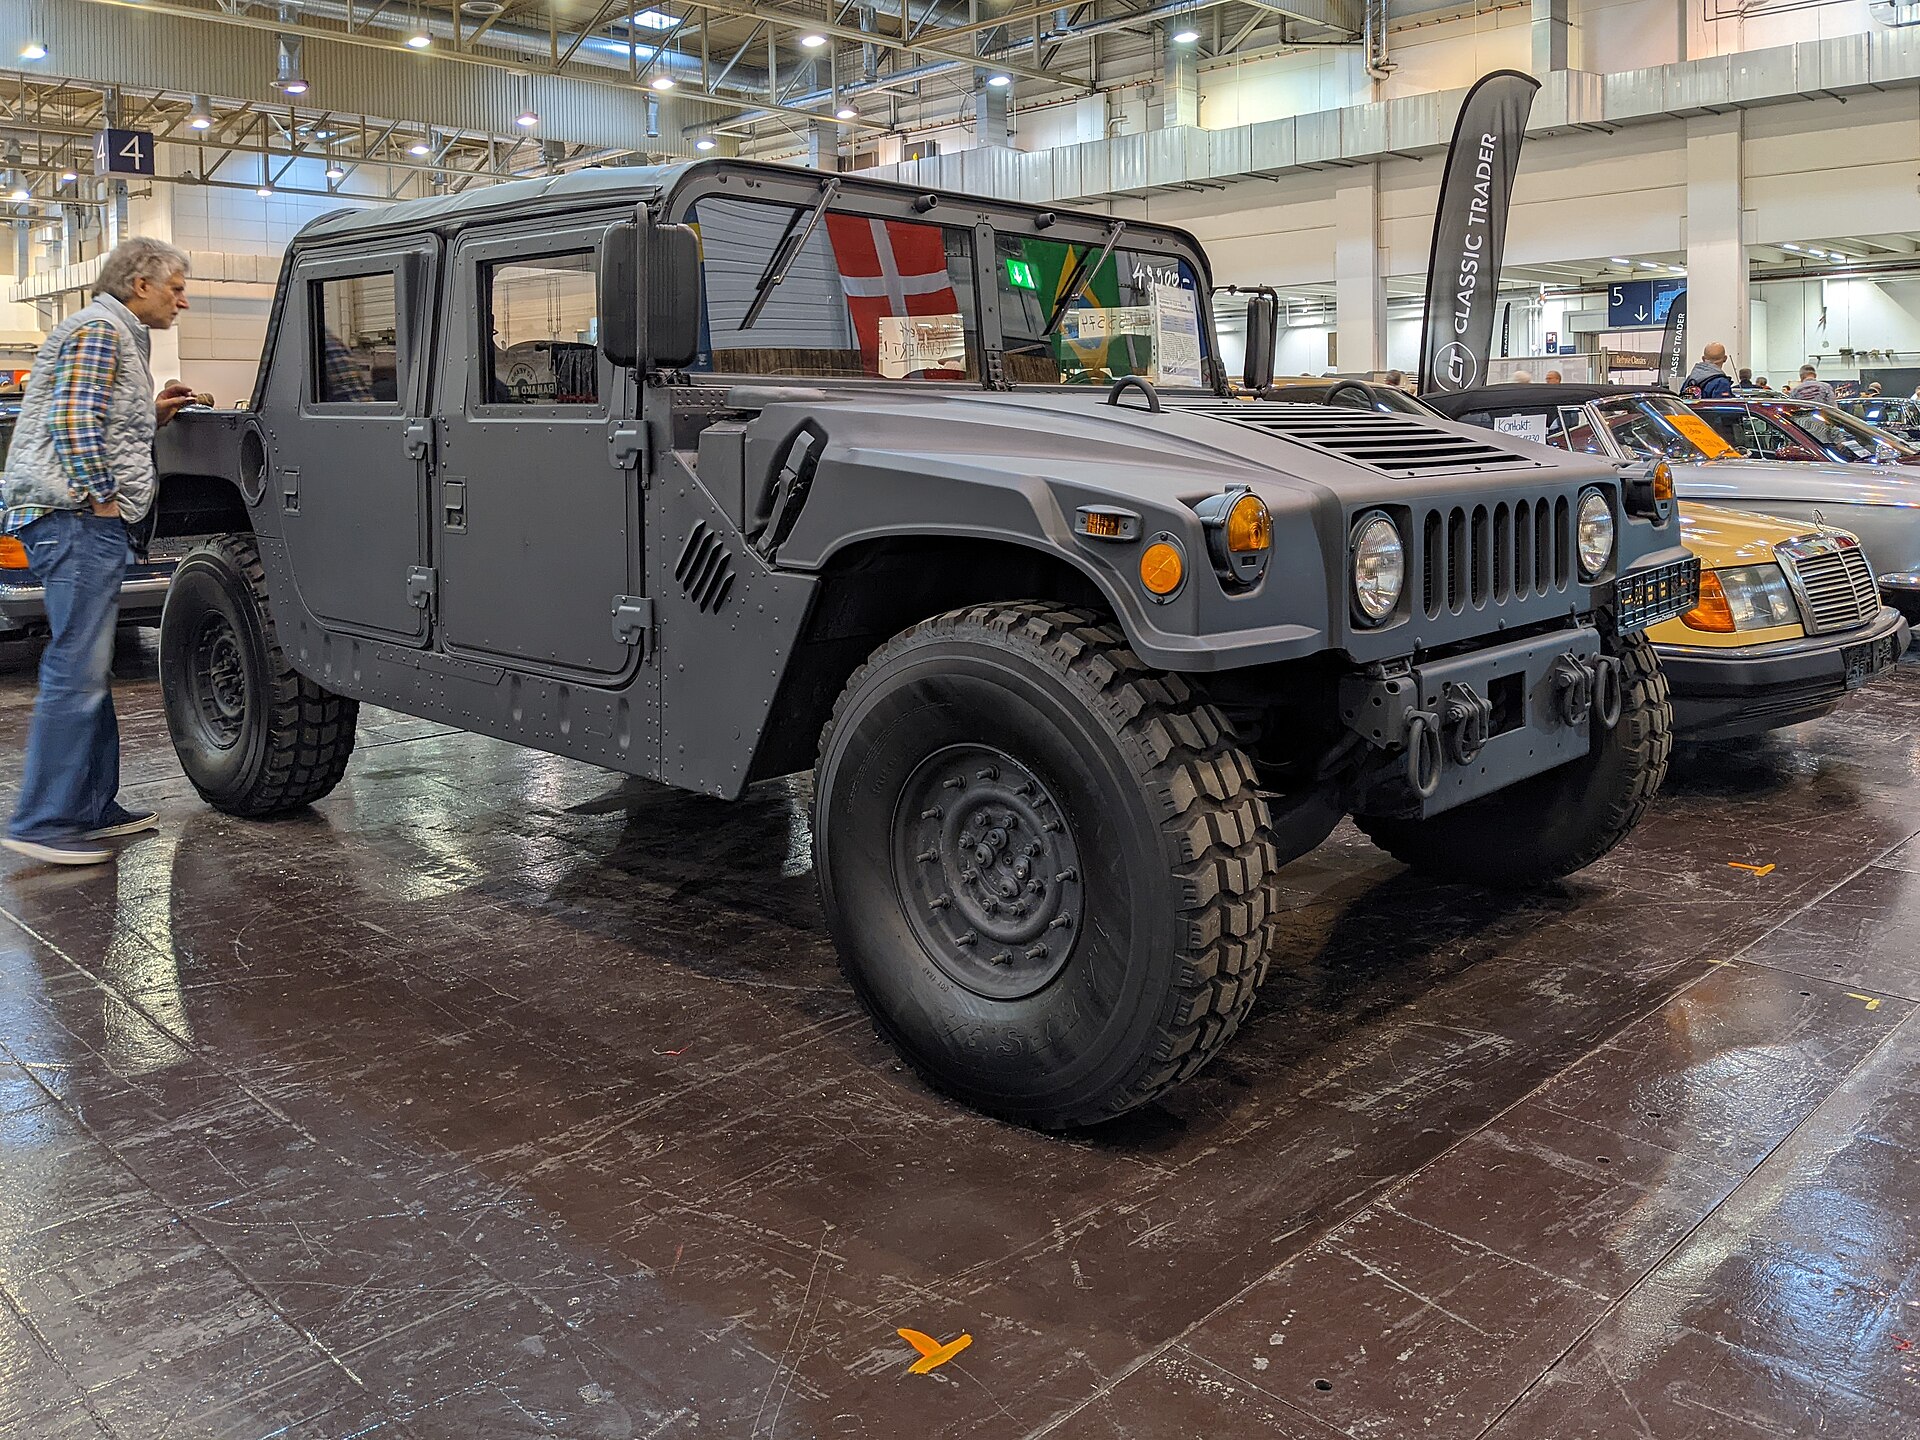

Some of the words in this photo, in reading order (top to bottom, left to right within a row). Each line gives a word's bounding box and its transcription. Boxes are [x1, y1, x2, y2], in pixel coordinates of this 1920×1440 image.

[97, 135, 105, 169] 4
[120, 135, 144, 169] 4
[1468, 132, 1497, 227] TRADER
[1454, 233, 1483, 334] CLASSIC
[1612, 286, 1624, 306] 5
[1674, 313, 1686, 346] TRADER
